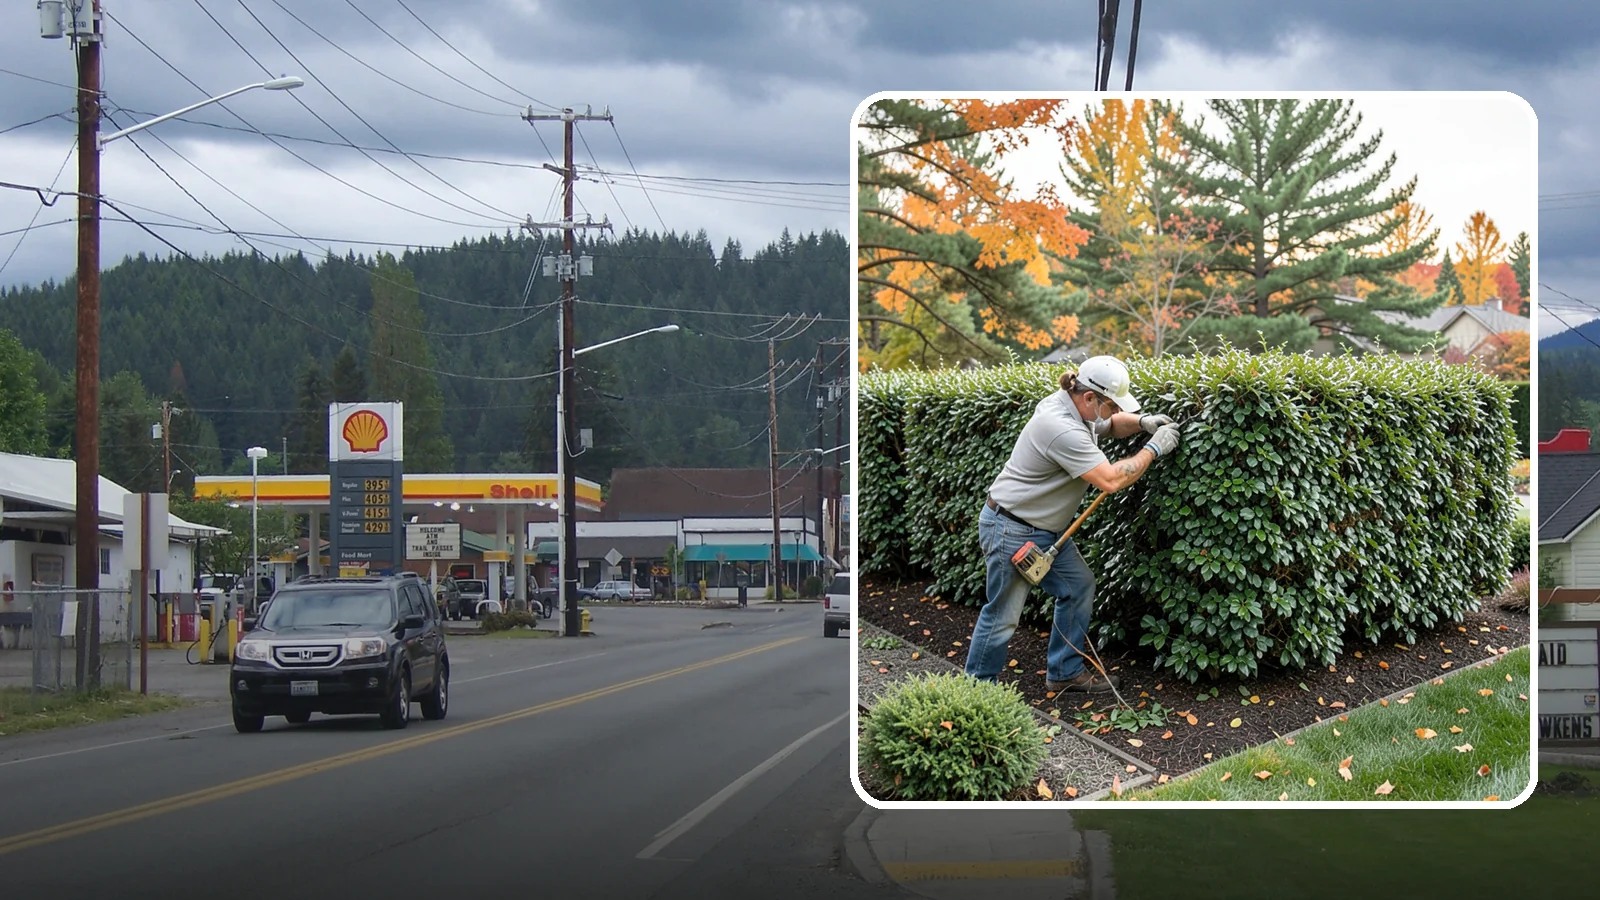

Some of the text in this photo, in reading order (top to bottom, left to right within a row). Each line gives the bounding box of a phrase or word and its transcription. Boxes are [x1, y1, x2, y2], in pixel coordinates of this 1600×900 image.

[366, 480, 383, 490] 395
[490, 484, 547, 498] Shell
[366, 494, 383, 504] 405
[366, 508, 383, 518] 415
[366, 522, 383, 532] 429
[1539, 643, 1567, 665] AID
